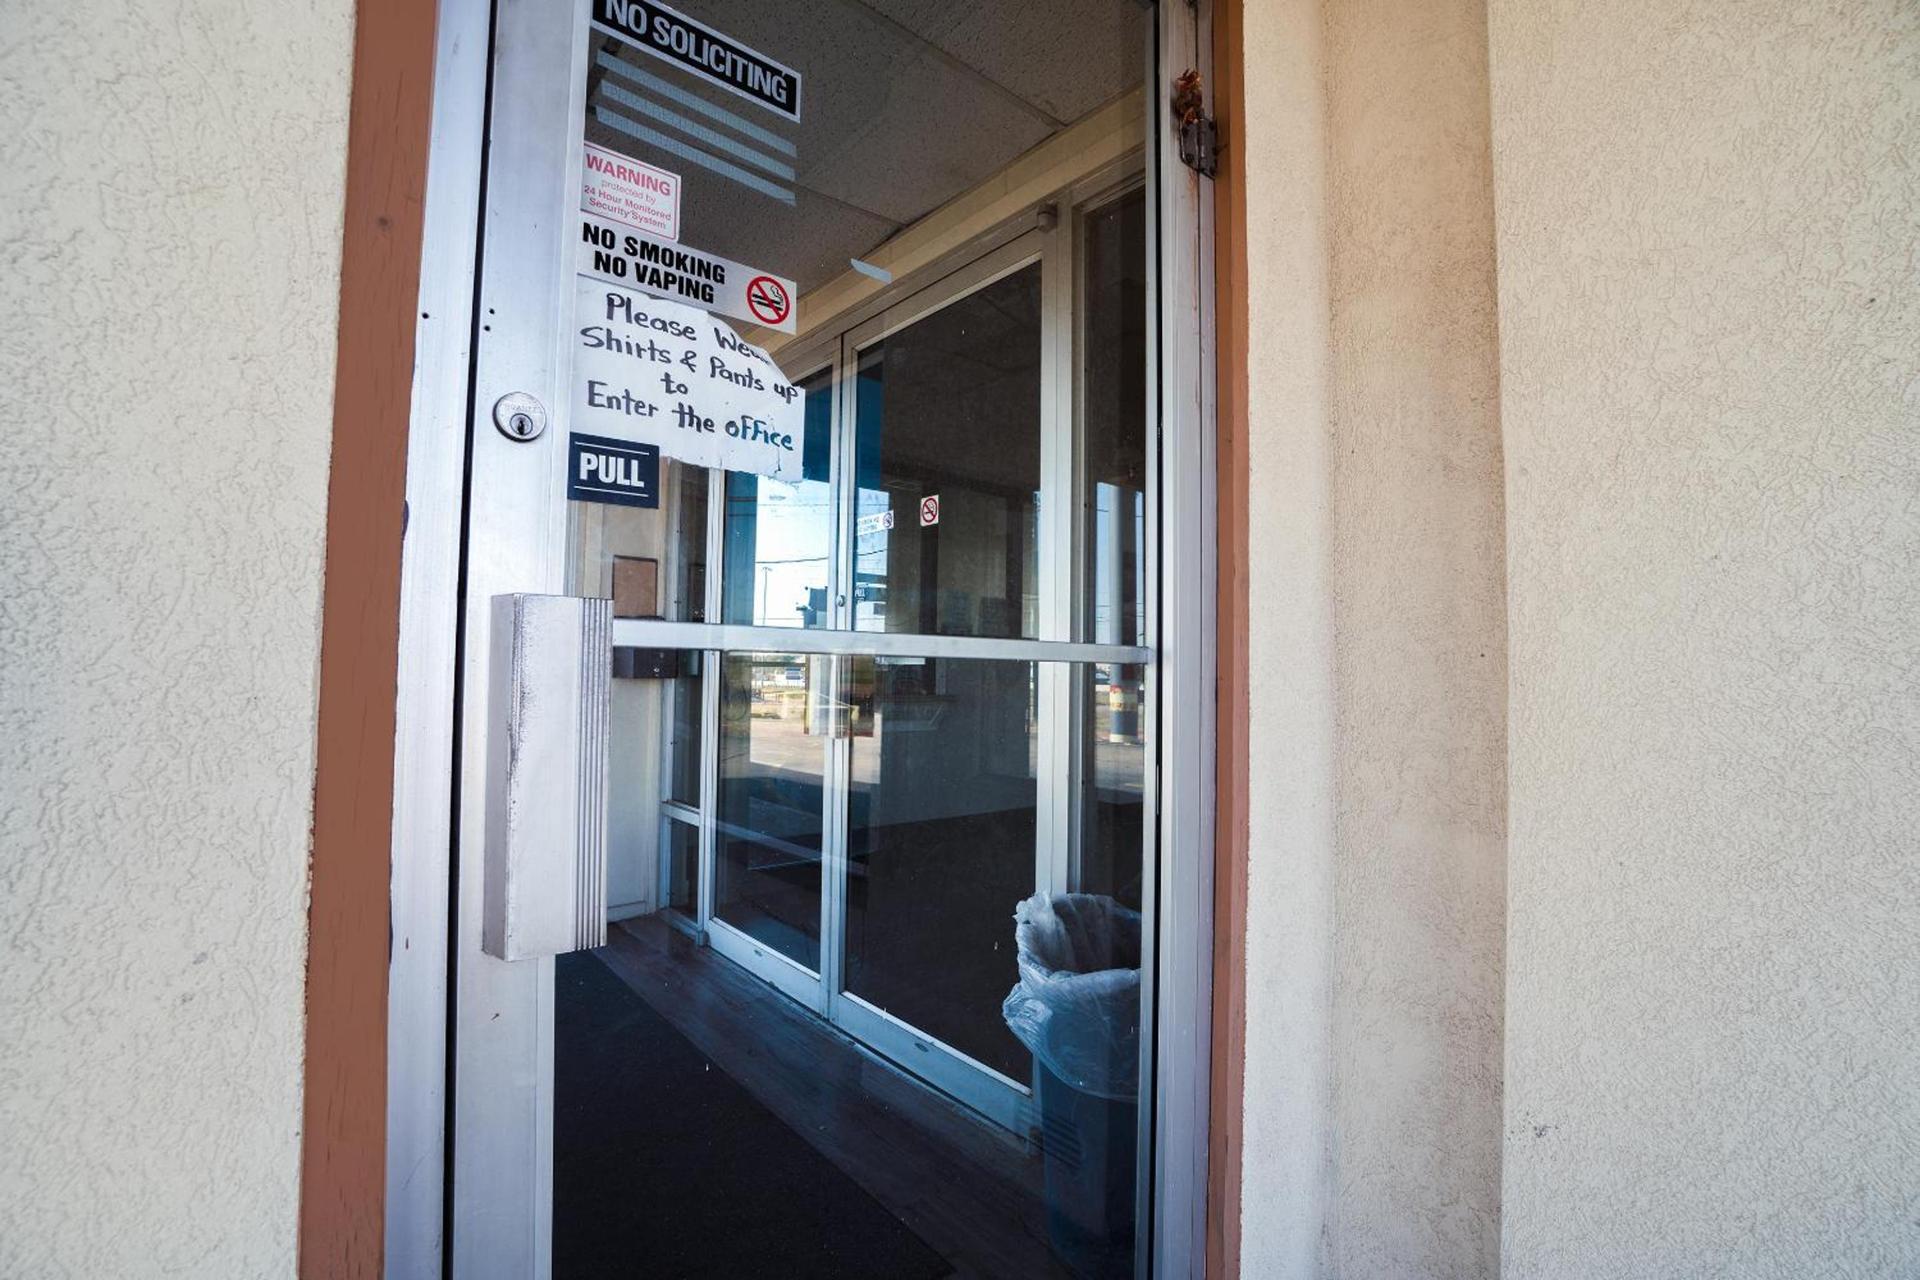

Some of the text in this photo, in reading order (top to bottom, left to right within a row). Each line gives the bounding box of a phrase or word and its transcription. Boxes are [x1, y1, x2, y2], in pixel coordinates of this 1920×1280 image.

[604, 0, 788, 104] NO SOLICITING
[586, 153, 671, 196] WARNING
[601, 180, 643, 199] protected
[584, 184, 672, 221] 24 Hour Monitored
[589, 197, 666, 229] Security System
[582, 222, 725, 284] NO SMOKING
[594, 250, 714, 304] NO VAPING
[606, 292, 769, 365] Please We
[580, 326, 671, 364] Shirts
[680, 350, 697, 373] &
[710, 356, 765, 391] Pants
[587, 380, 659, 417] Enter
[671, 401, 715, 433] the
[660, 372, 689, 395] to
[579, 452, 645, 488] PULL
